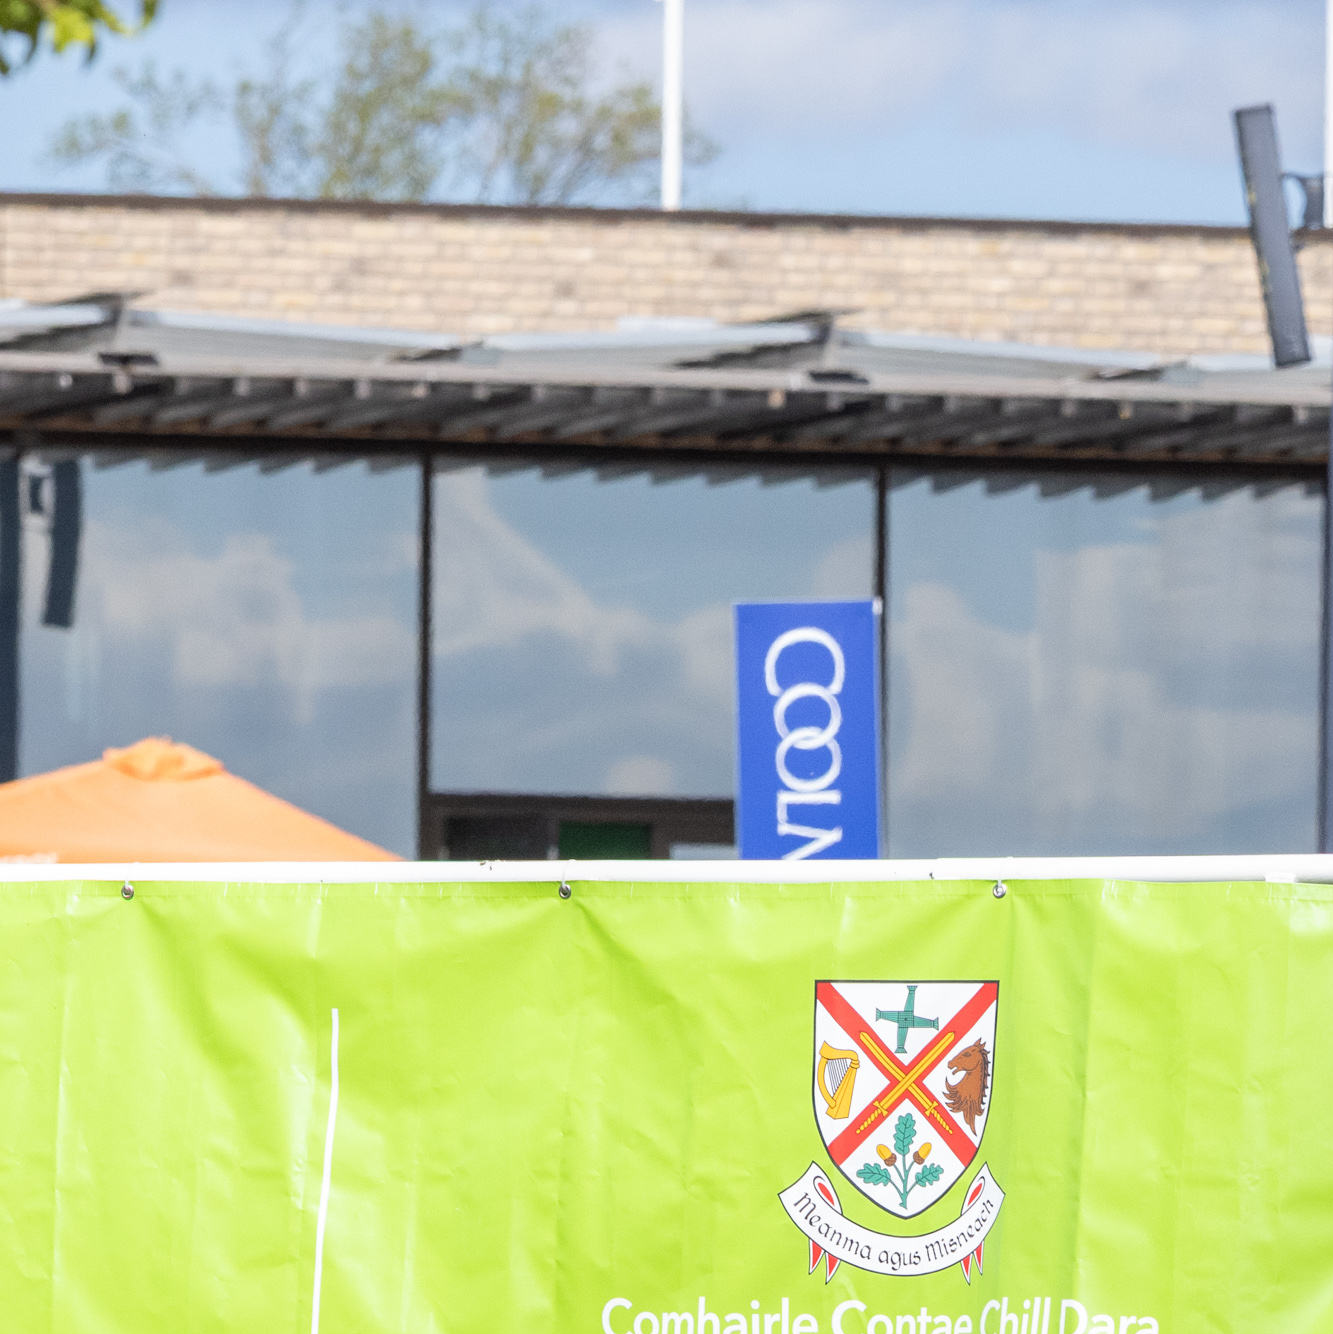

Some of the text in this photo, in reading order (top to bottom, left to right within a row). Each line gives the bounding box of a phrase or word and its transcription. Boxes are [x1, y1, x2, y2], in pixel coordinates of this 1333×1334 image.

[793, 1191, 994, 1272] Meanma agus Misneach
